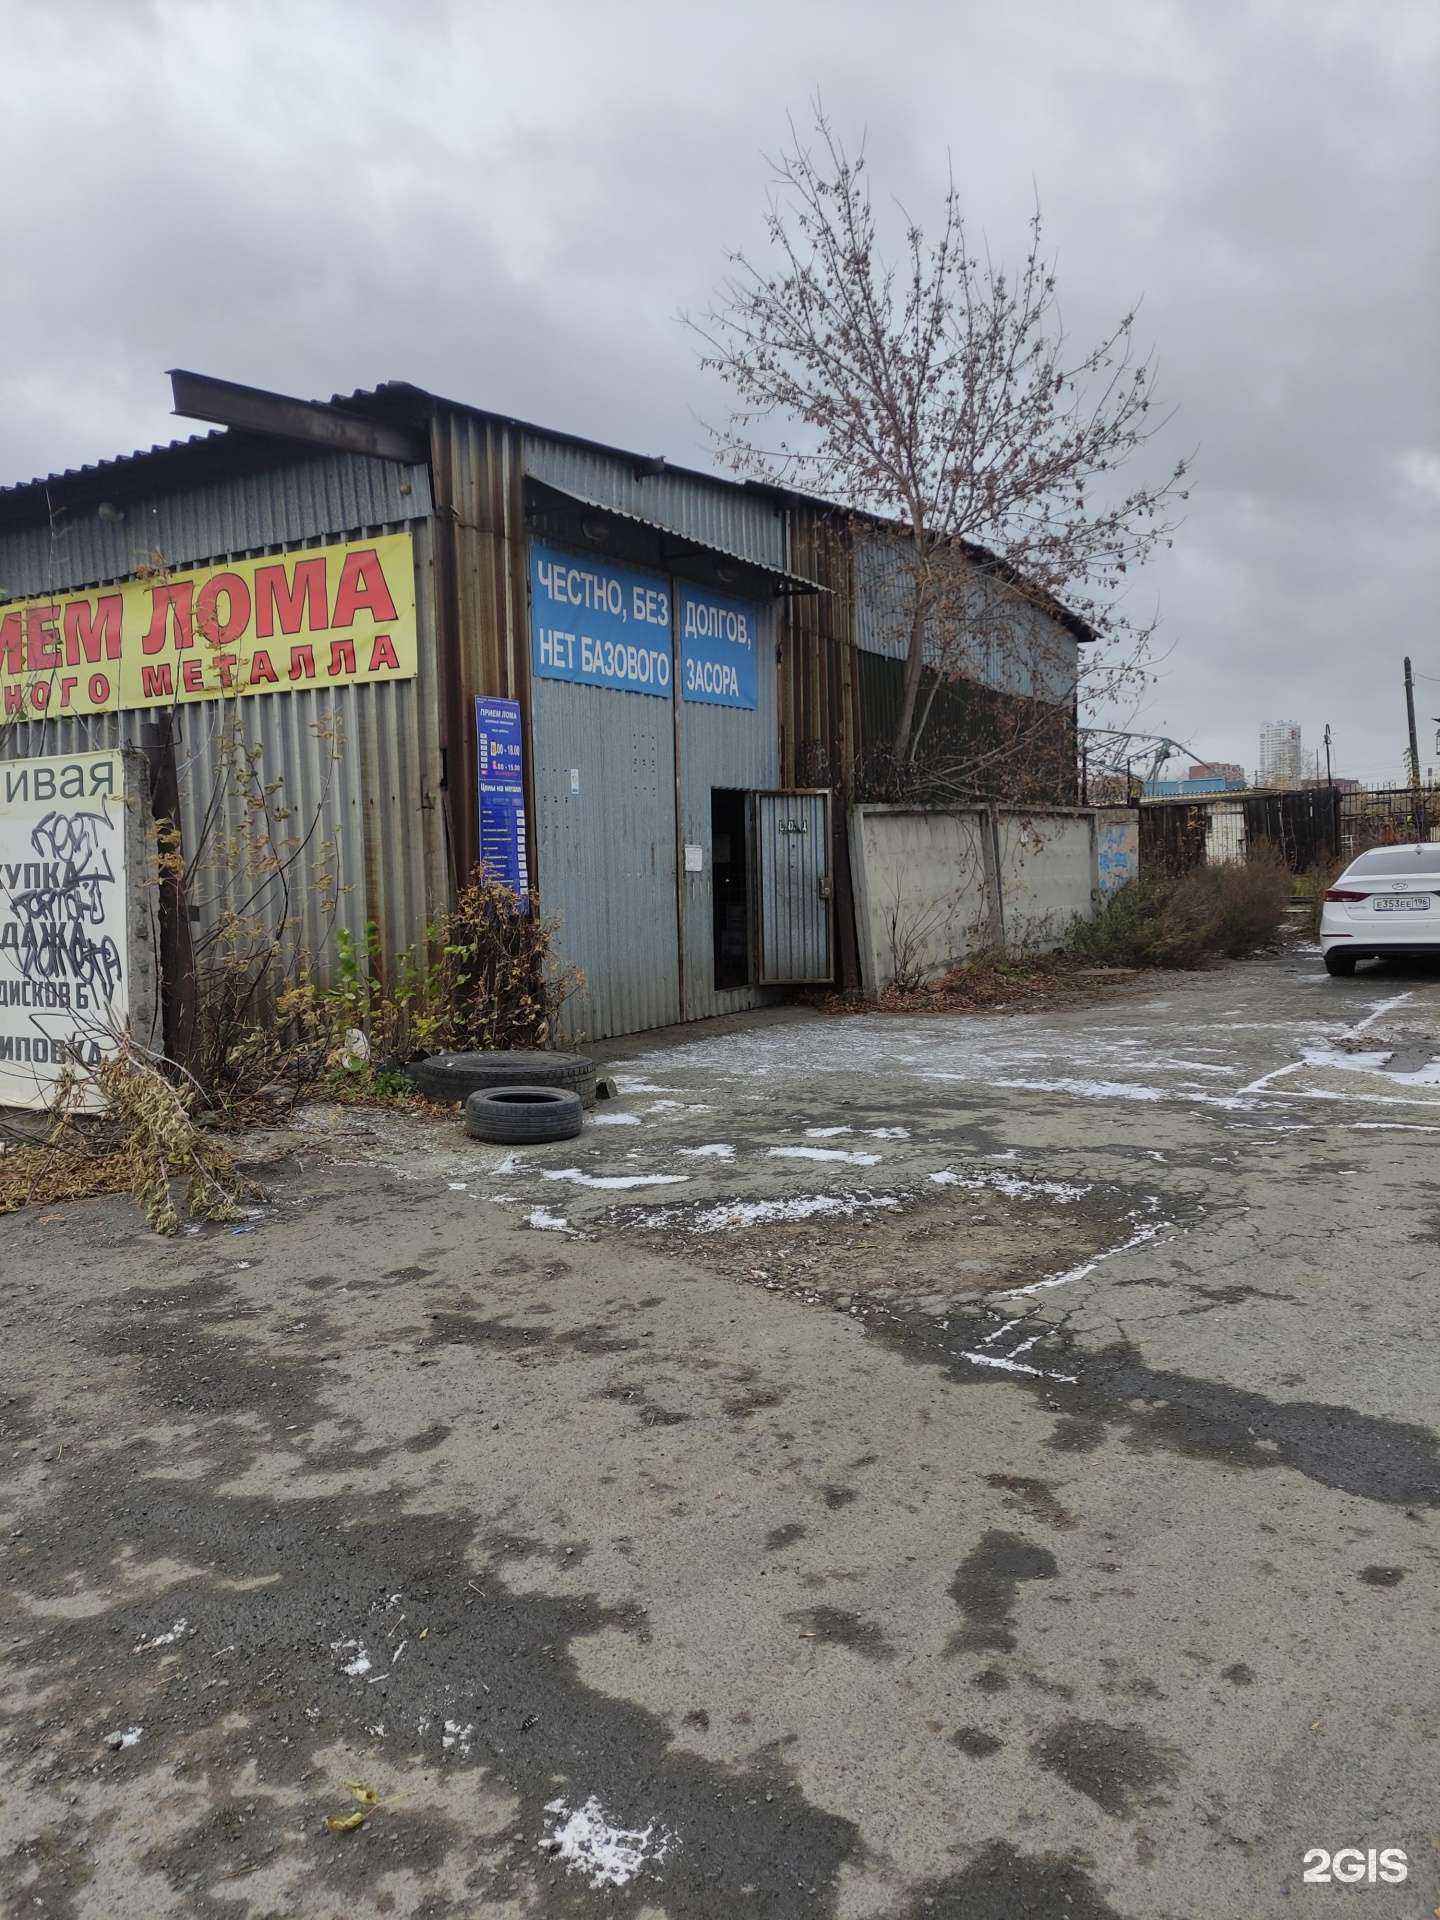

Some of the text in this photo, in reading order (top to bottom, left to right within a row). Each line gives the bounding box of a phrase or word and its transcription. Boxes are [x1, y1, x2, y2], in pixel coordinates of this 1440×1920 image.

[141, 549, 399, 655] ЛОМА
[537, 560, 752, 649] ЧЕСТНО, БЕЗ ДОЛГОВ,
[4, 635, 400, 714] НОГО МЕТАЛЛА
[539, 628, 739, 697] НЕТ БАЗОВОГО ЗАСОРА
